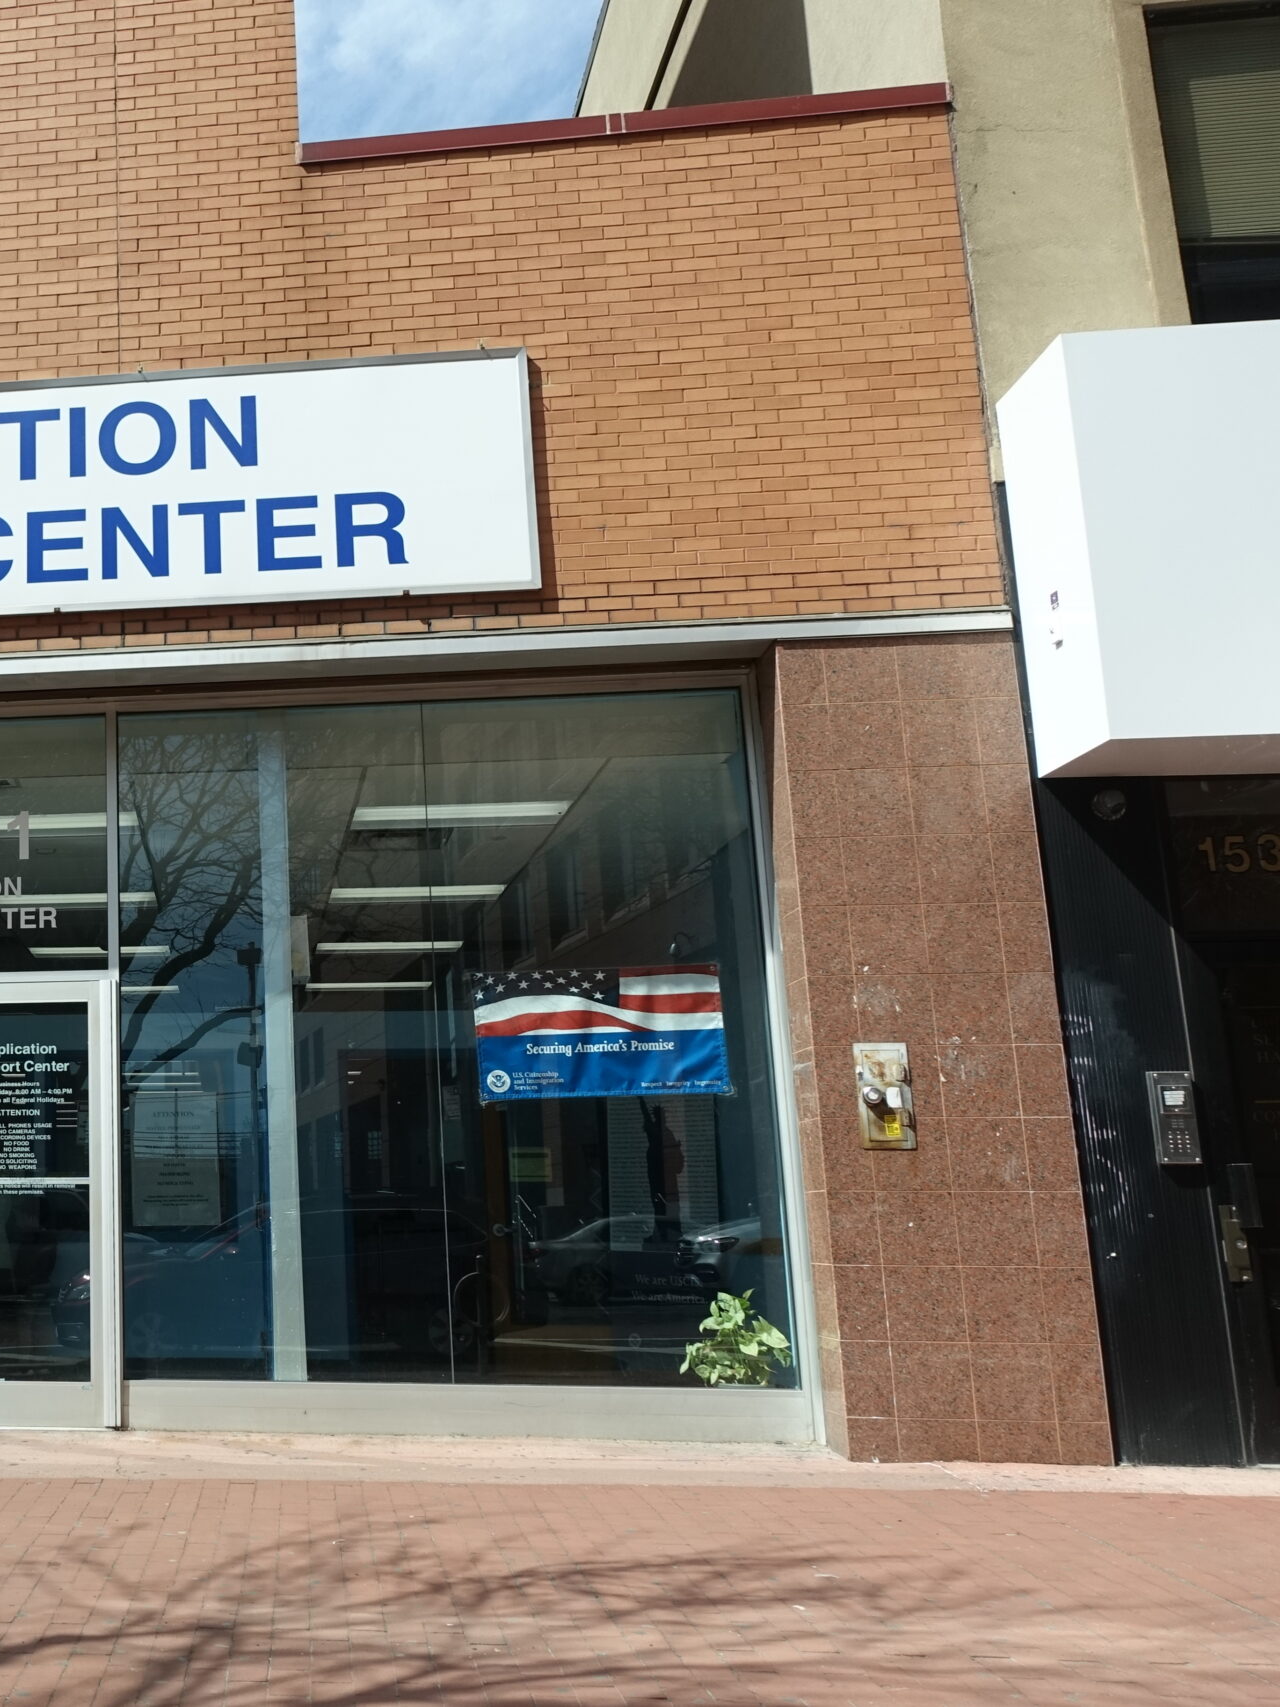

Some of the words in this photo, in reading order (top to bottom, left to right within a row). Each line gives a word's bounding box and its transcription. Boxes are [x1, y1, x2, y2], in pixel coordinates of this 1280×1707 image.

[526, 1042, 572, 1056] Securing
[575, 1040, 627, 1053] America's
[630, 1039, 674, 1051] Promise
[24, 1060, 69, 1072] Center
[36, 1096, 65, 1104] Holidays
